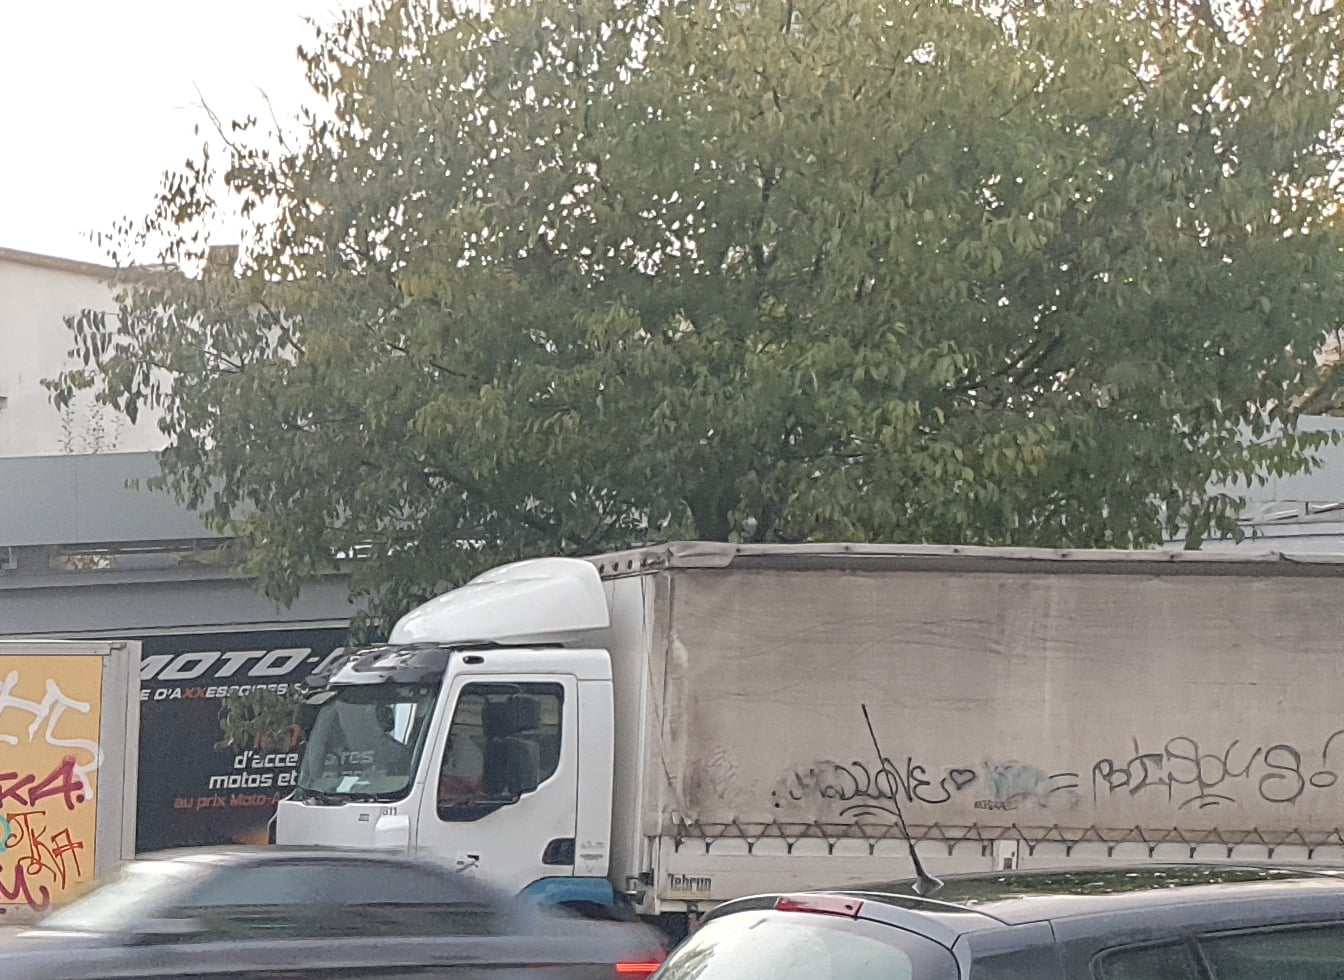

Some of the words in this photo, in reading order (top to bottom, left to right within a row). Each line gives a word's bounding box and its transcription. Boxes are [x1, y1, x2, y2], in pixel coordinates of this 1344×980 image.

[208, 771, 273, 789] motos
[277, 769, 298, 787] et
[174, 796, 193, 809] au
[195, 793, 225, 811] prix
